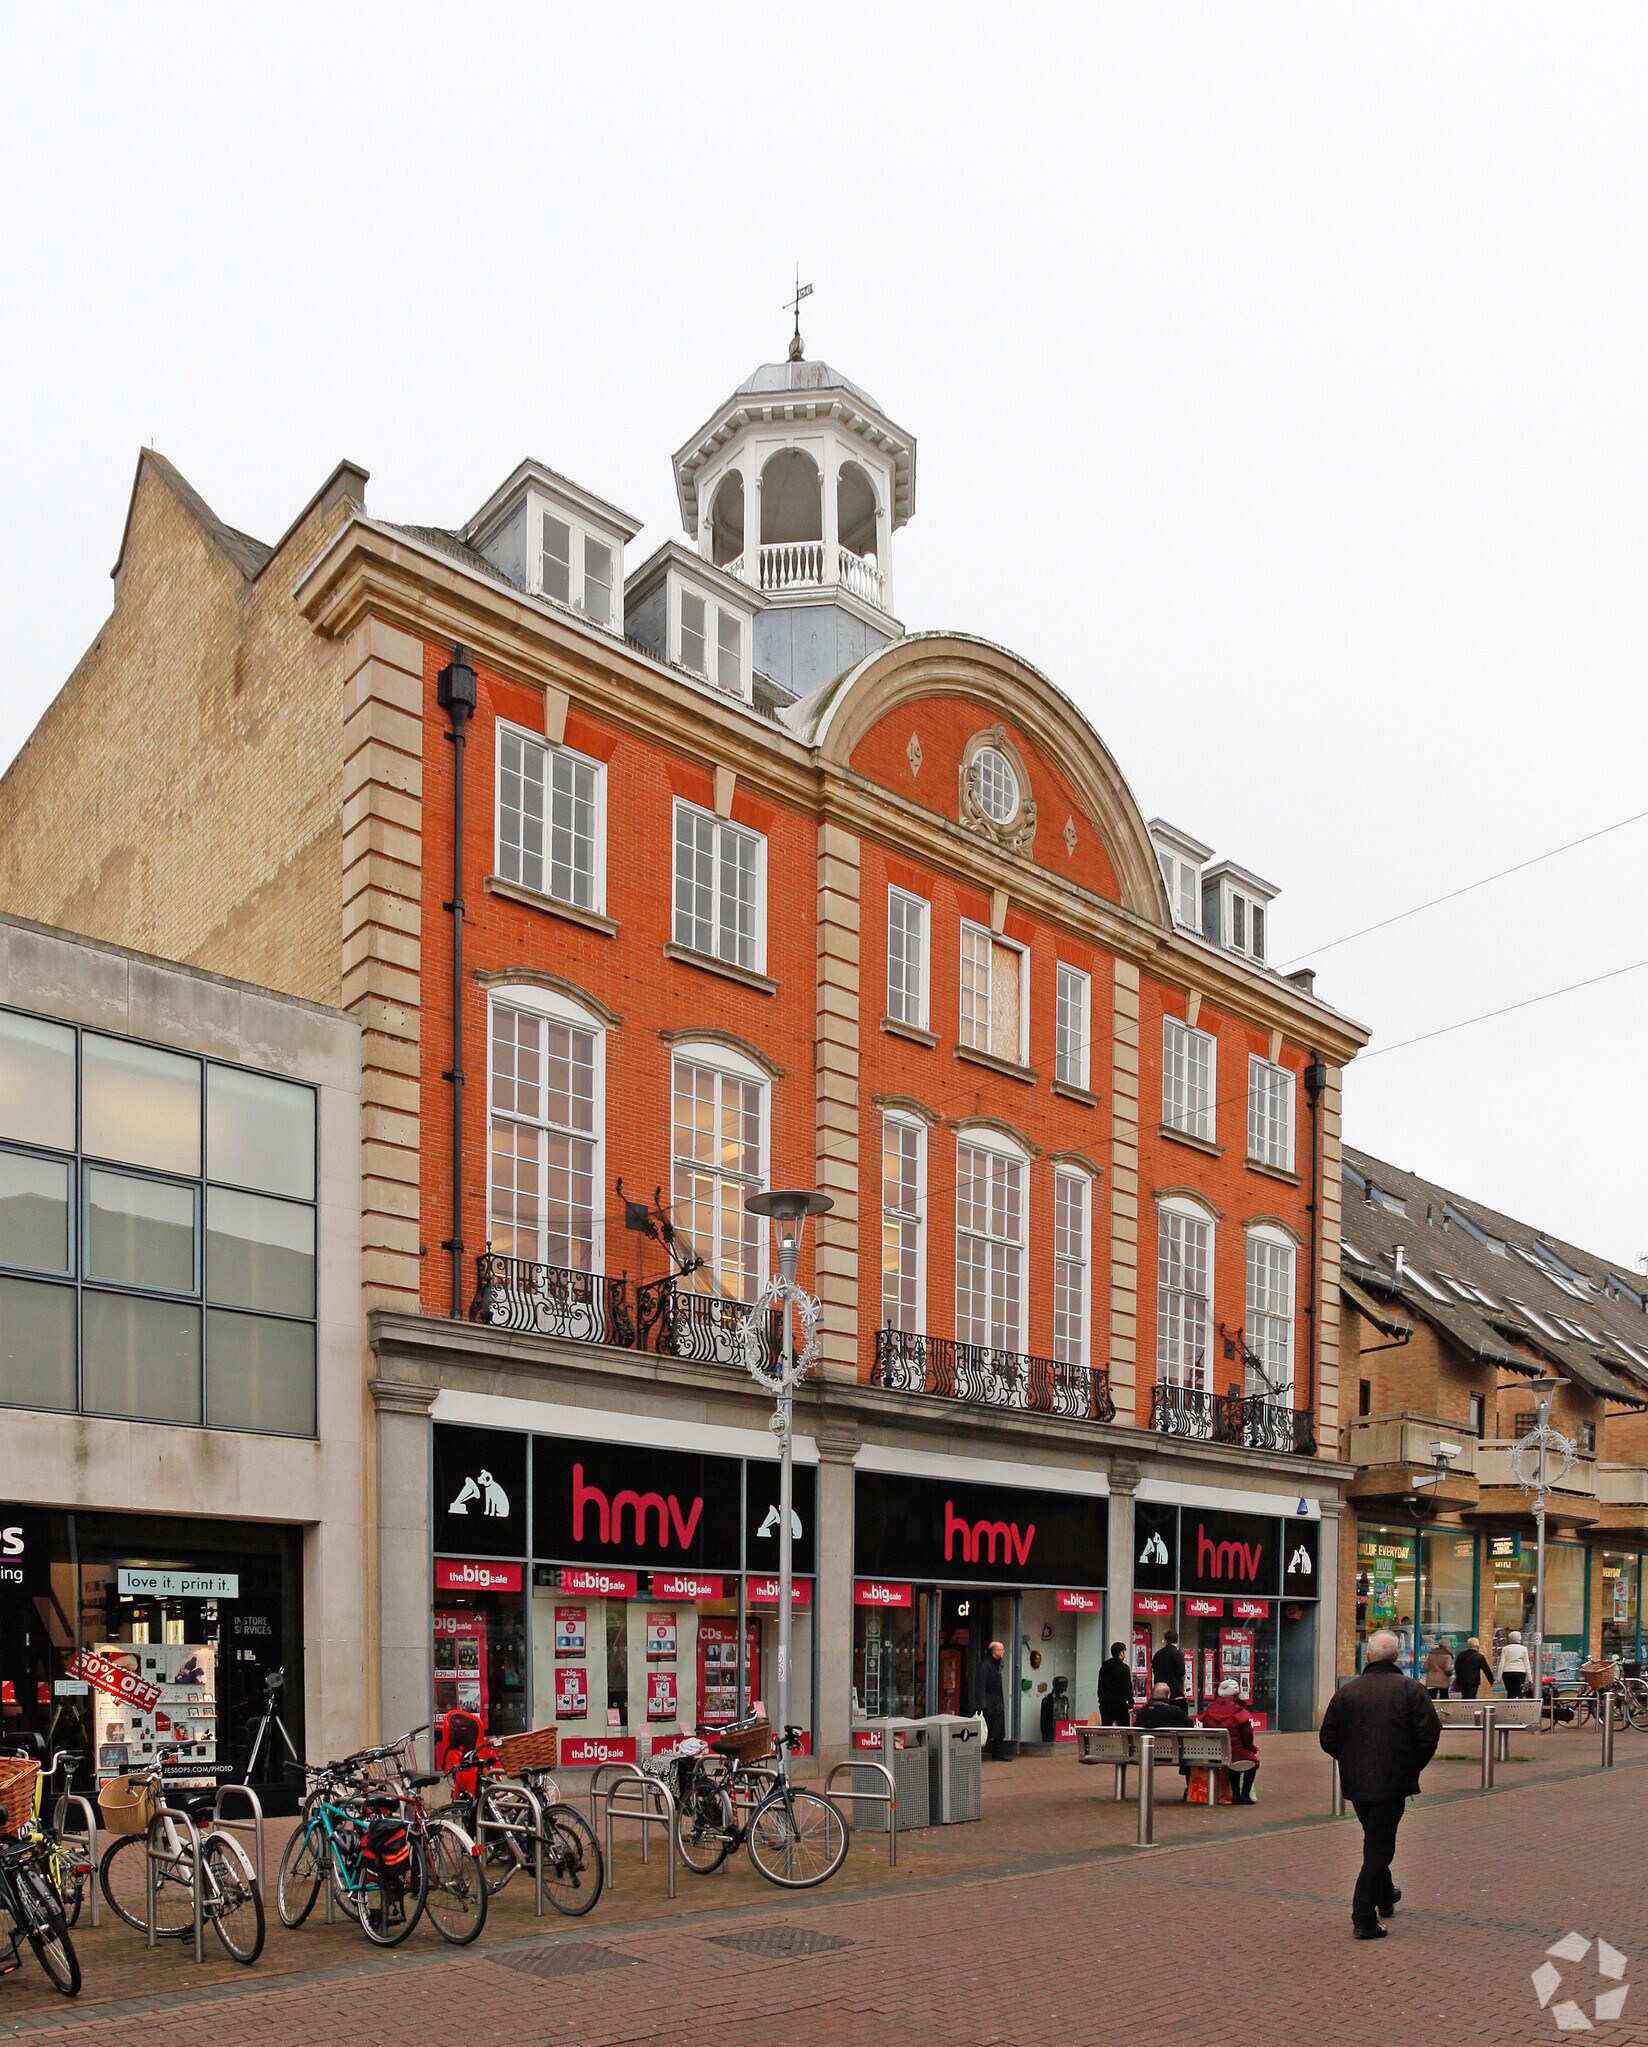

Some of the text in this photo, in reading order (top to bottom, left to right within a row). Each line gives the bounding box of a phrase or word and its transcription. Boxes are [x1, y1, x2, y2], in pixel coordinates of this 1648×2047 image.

[573, 1463, 703, 1550] hmv
[0, 1527, 25, 1555] S
[945, 1500, 1035, 1566] hmv
[1198, 1524, 1262, 1582] hmv
[1378, 1545, 1410, 1559] EVERYDAY
[1375, 1558, 1394, 1571] WOW
[127, 1572, 230, 1593] love it. print it.
[463, 1564, 490, 1587] big
[585, 1571, 609, 1593] big
[675, 1577, 697, 1597] big
[767, 1581, 780, 1597] bi
[872, 1584, 890, 1603] big
[1070, 1593, 1084, 1609] big
[1145, 1598, 1158, 1612] big
[1196, 1600, 1208, 1614] big
[1243, 1602, 1254, 1615] big
[244, 1616, 268, 1626] STORE
[234, 1625, 272, 1635] SRVICES
[700, 1627, 722, 1640] CDs
[74, 1653, 159, 1702] 50% OFF
[584, 1742, 608, 1761] big
[164, 1765, 234, 1774] JESSOPS.COM/PHOTO
